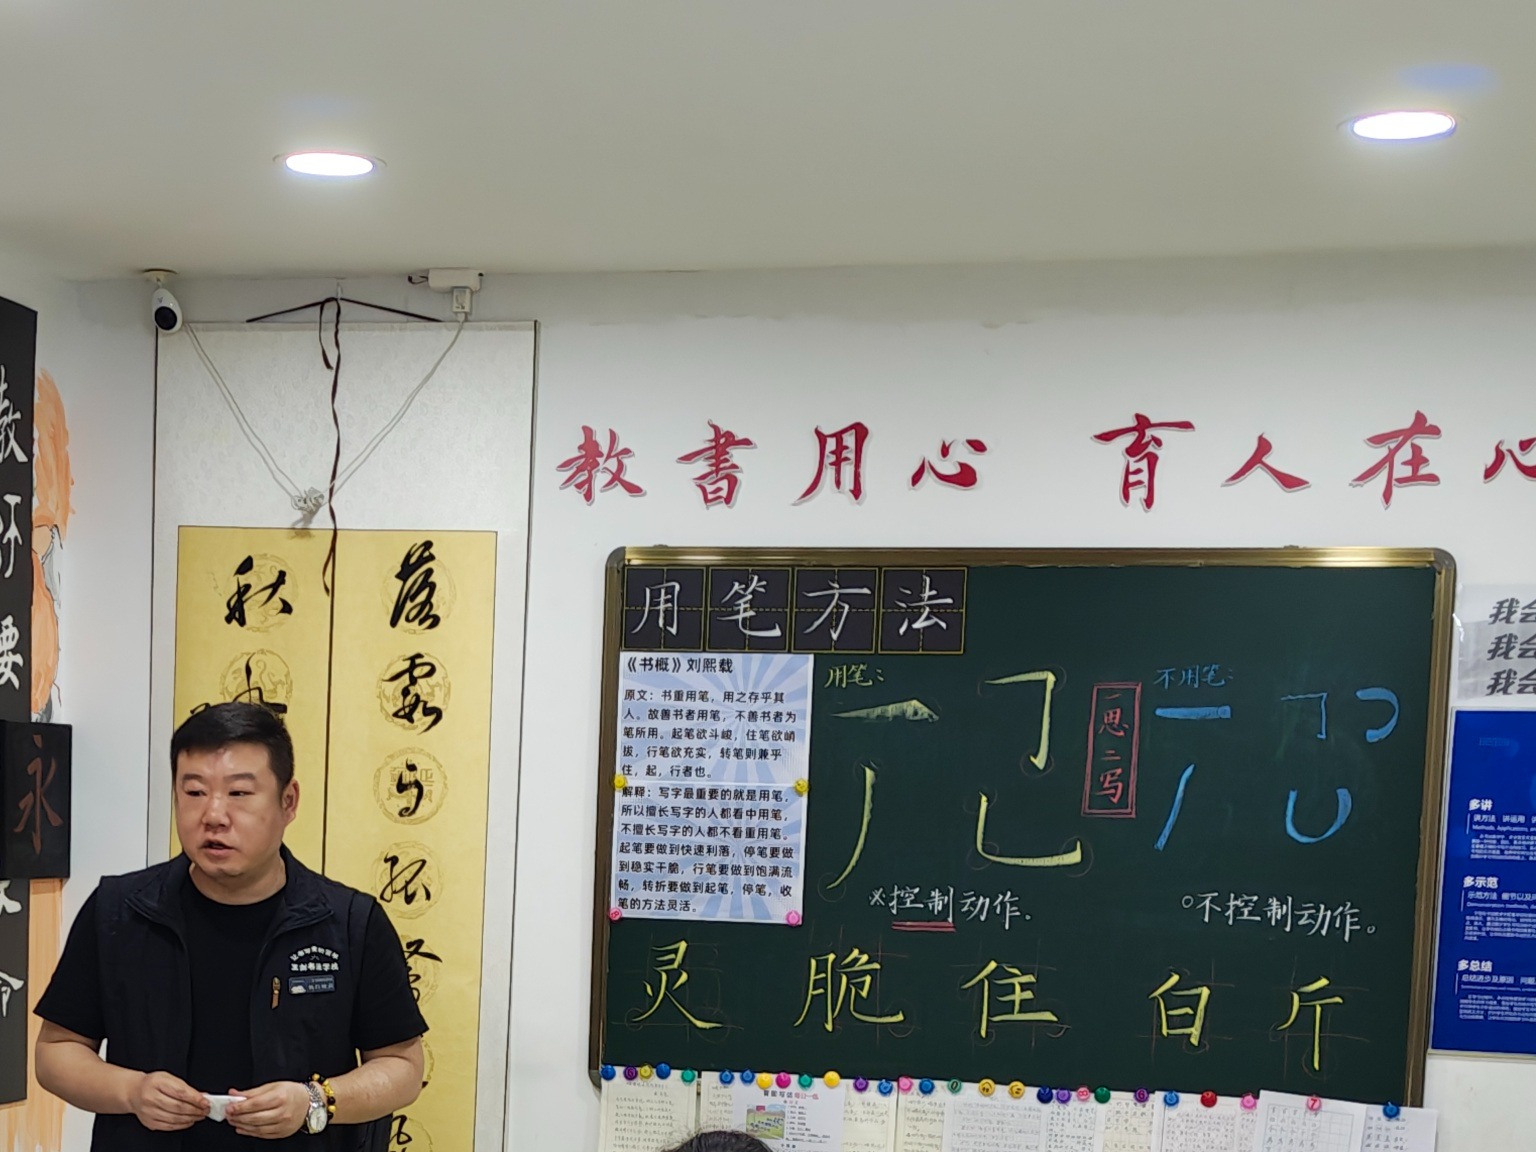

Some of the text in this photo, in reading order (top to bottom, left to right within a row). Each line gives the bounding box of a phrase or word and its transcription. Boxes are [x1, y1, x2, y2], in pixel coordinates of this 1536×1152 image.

[632, 575, 954, 641] 用笔方法
[1463, 875, 1499, 889] 多示范
[634, 940, 723, 1029] 灵
[794, 953, 905, 1033] 脆
[962, 959, 1060, 1038] 住
[1457, 959, 1493, 973] 多总结
[1147, 973, 1212, 1047] 白
[1276, 976, 1343, 1071] 斤
